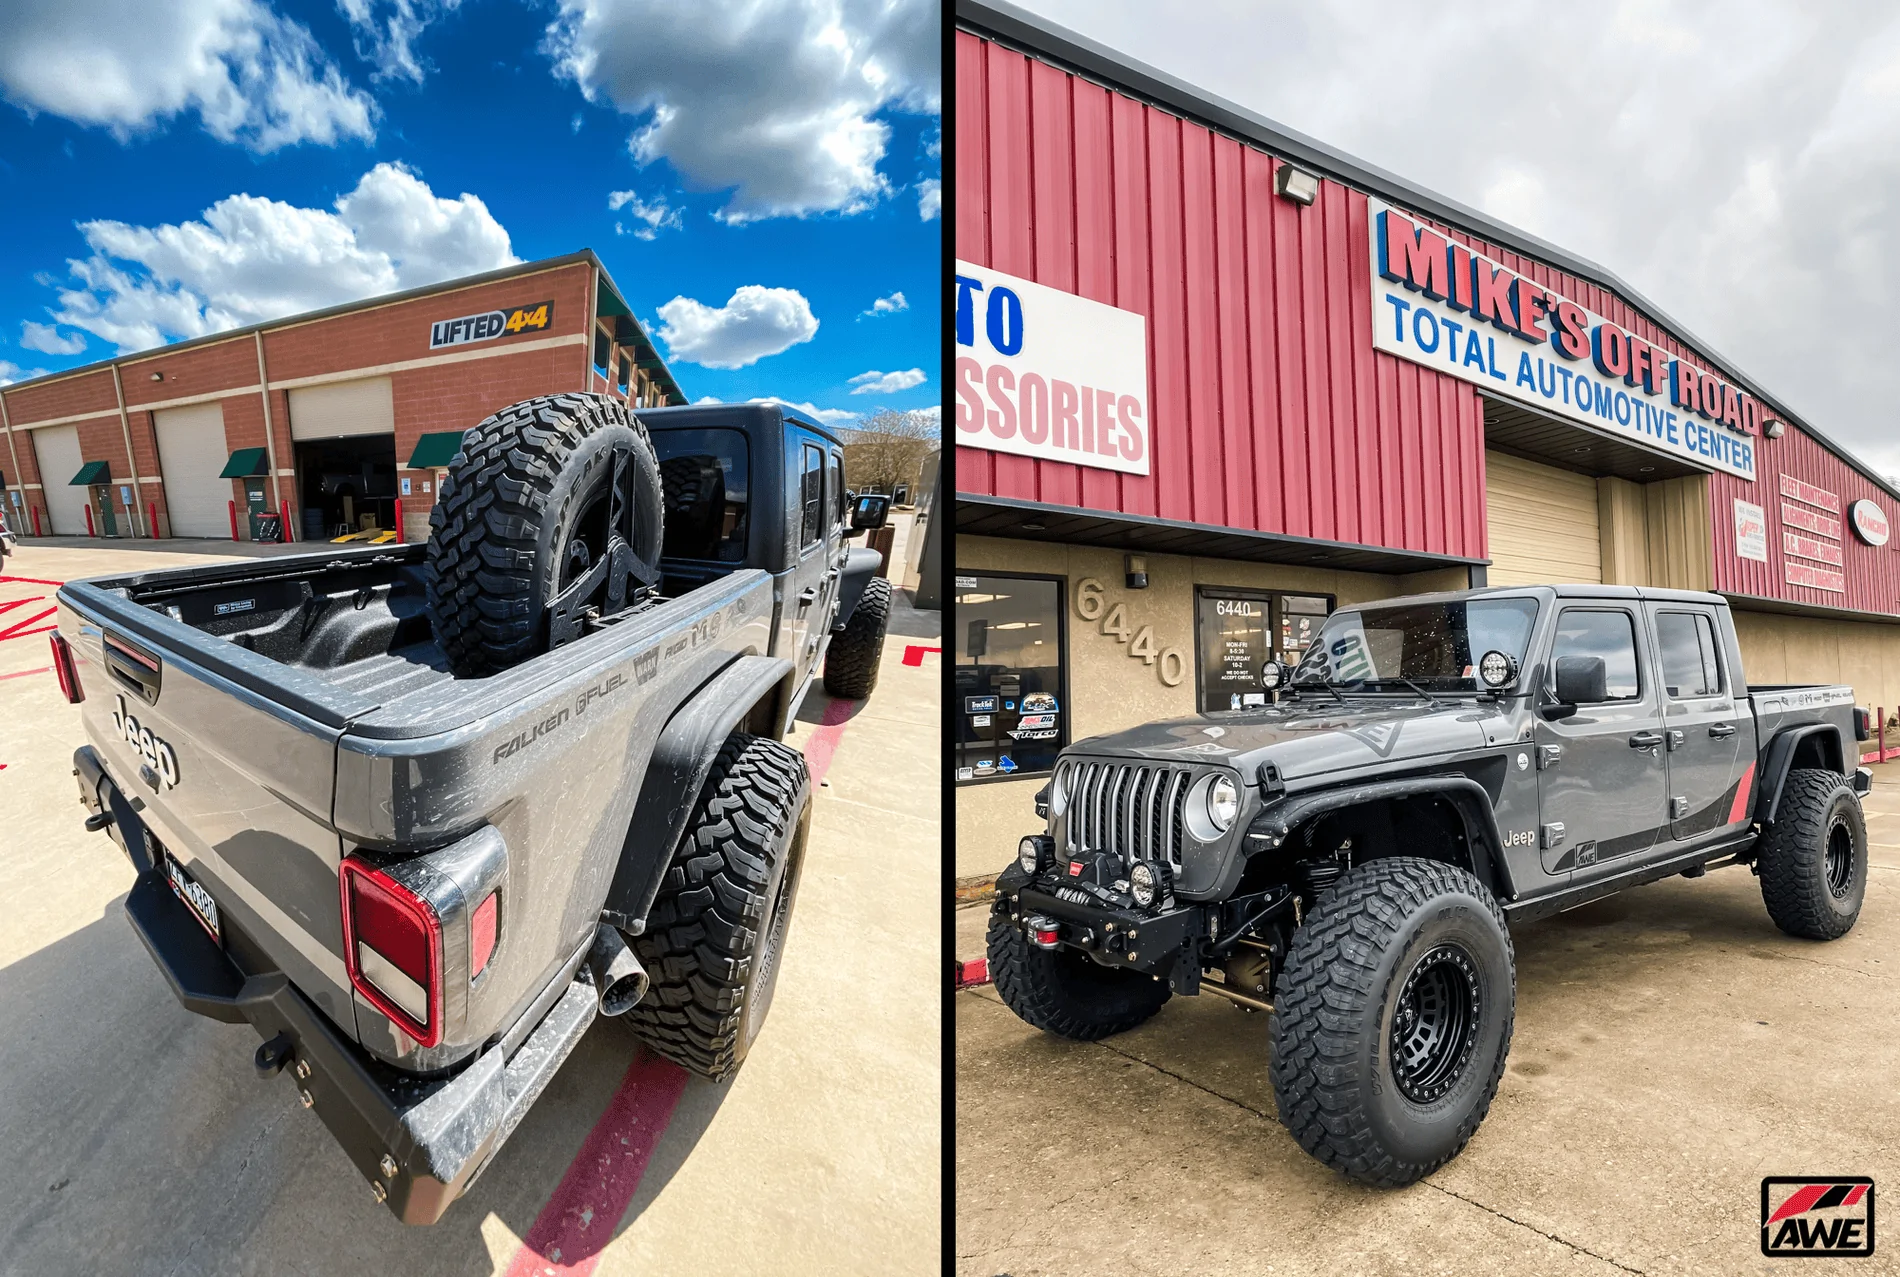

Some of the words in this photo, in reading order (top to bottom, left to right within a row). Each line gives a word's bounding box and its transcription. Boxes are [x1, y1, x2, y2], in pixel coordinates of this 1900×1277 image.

[432, 313, 504, 346] LIFTED
[1377, 209, 1591, 361] MIKE'S
[1592, 322, 1669, 396] OFF
[1669, 359, 1760, 437] ROAD
[1385, 293, 1507, 382] TOTAL
[1516, 350, 1679, 446] AUTOMOTIVE
[1684, 420, 1753, 473] CENTER
[1075, 577, 1186, 687] 6440
[1217, 600, 1251, 616] 6440
[112, 693, 181, 791] Jeep
[493, 707, 570, 765] FALKEN
[1503, 830, 1535, 848] Jeep
